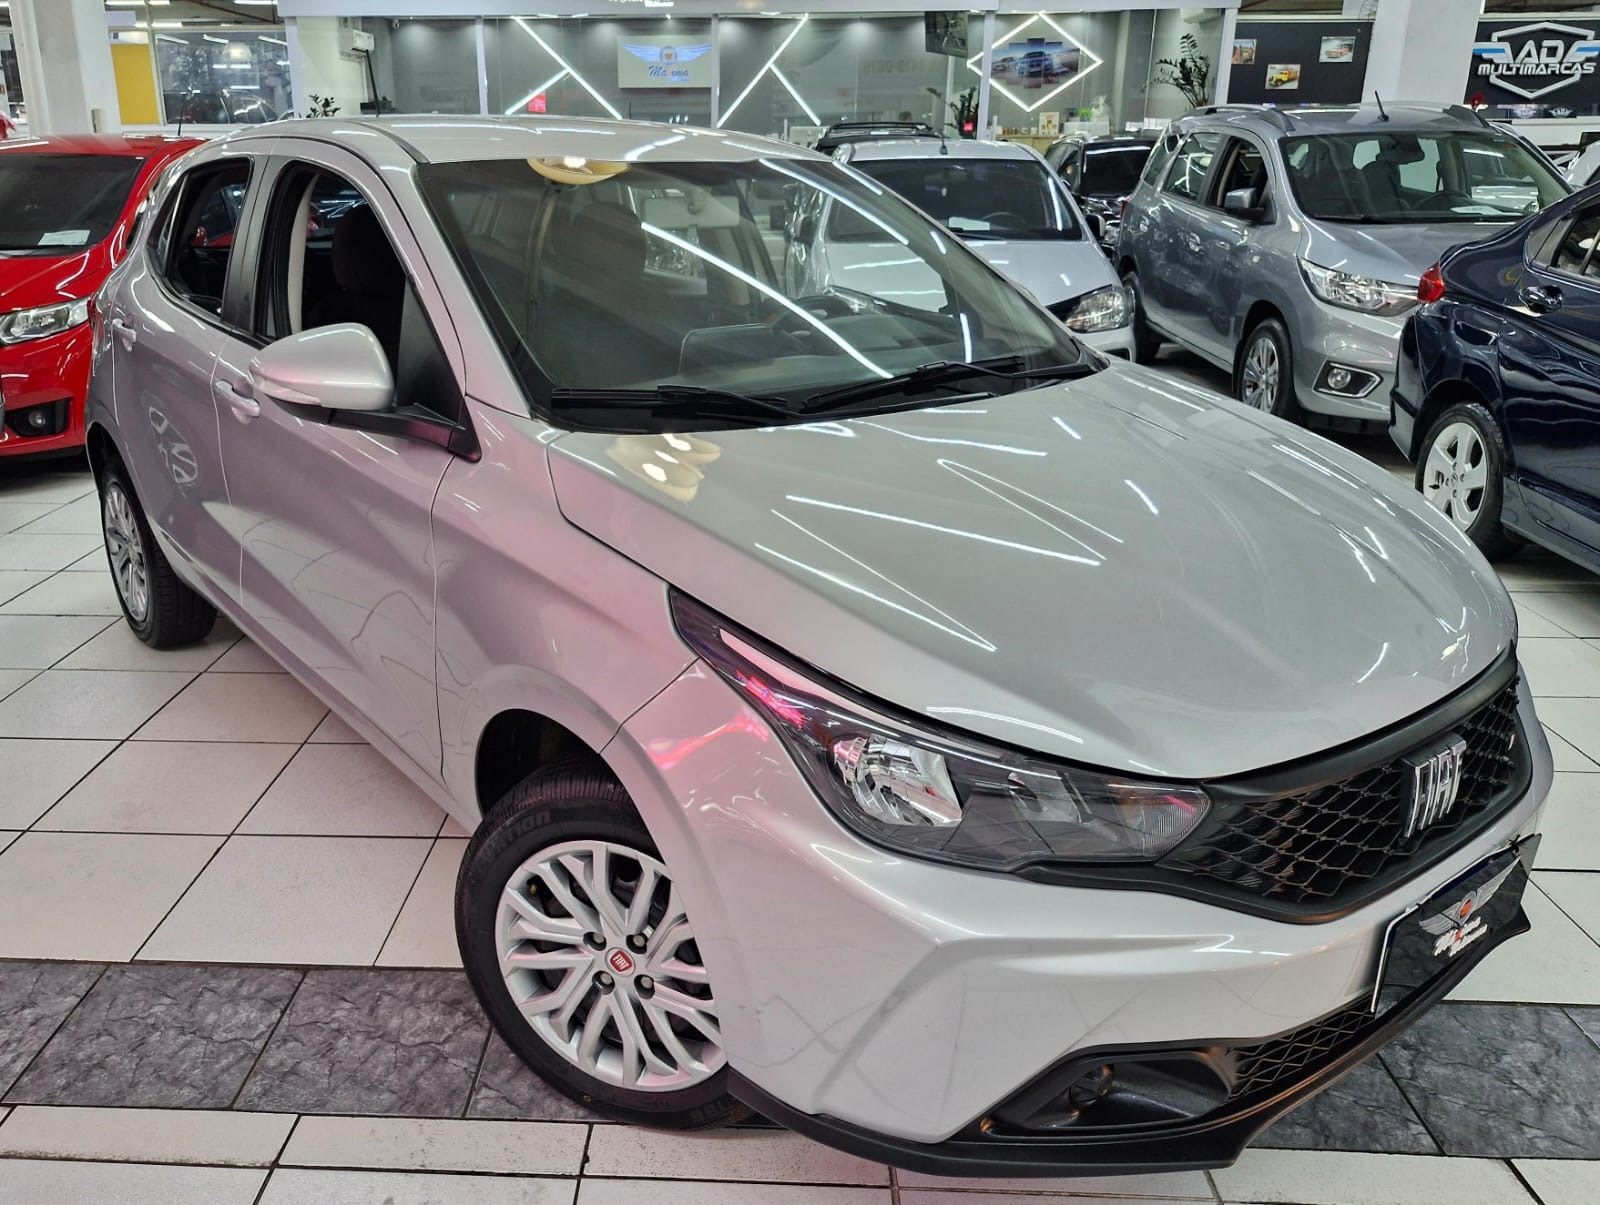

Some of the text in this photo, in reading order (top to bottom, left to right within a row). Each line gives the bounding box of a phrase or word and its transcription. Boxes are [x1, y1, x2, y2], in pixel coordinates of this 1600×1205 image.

[1514, 40, 1564, 64] AD
[1478, 62, 1597, 76] MULTIMARCAS
[612, 953, 630, 971] FIAT
